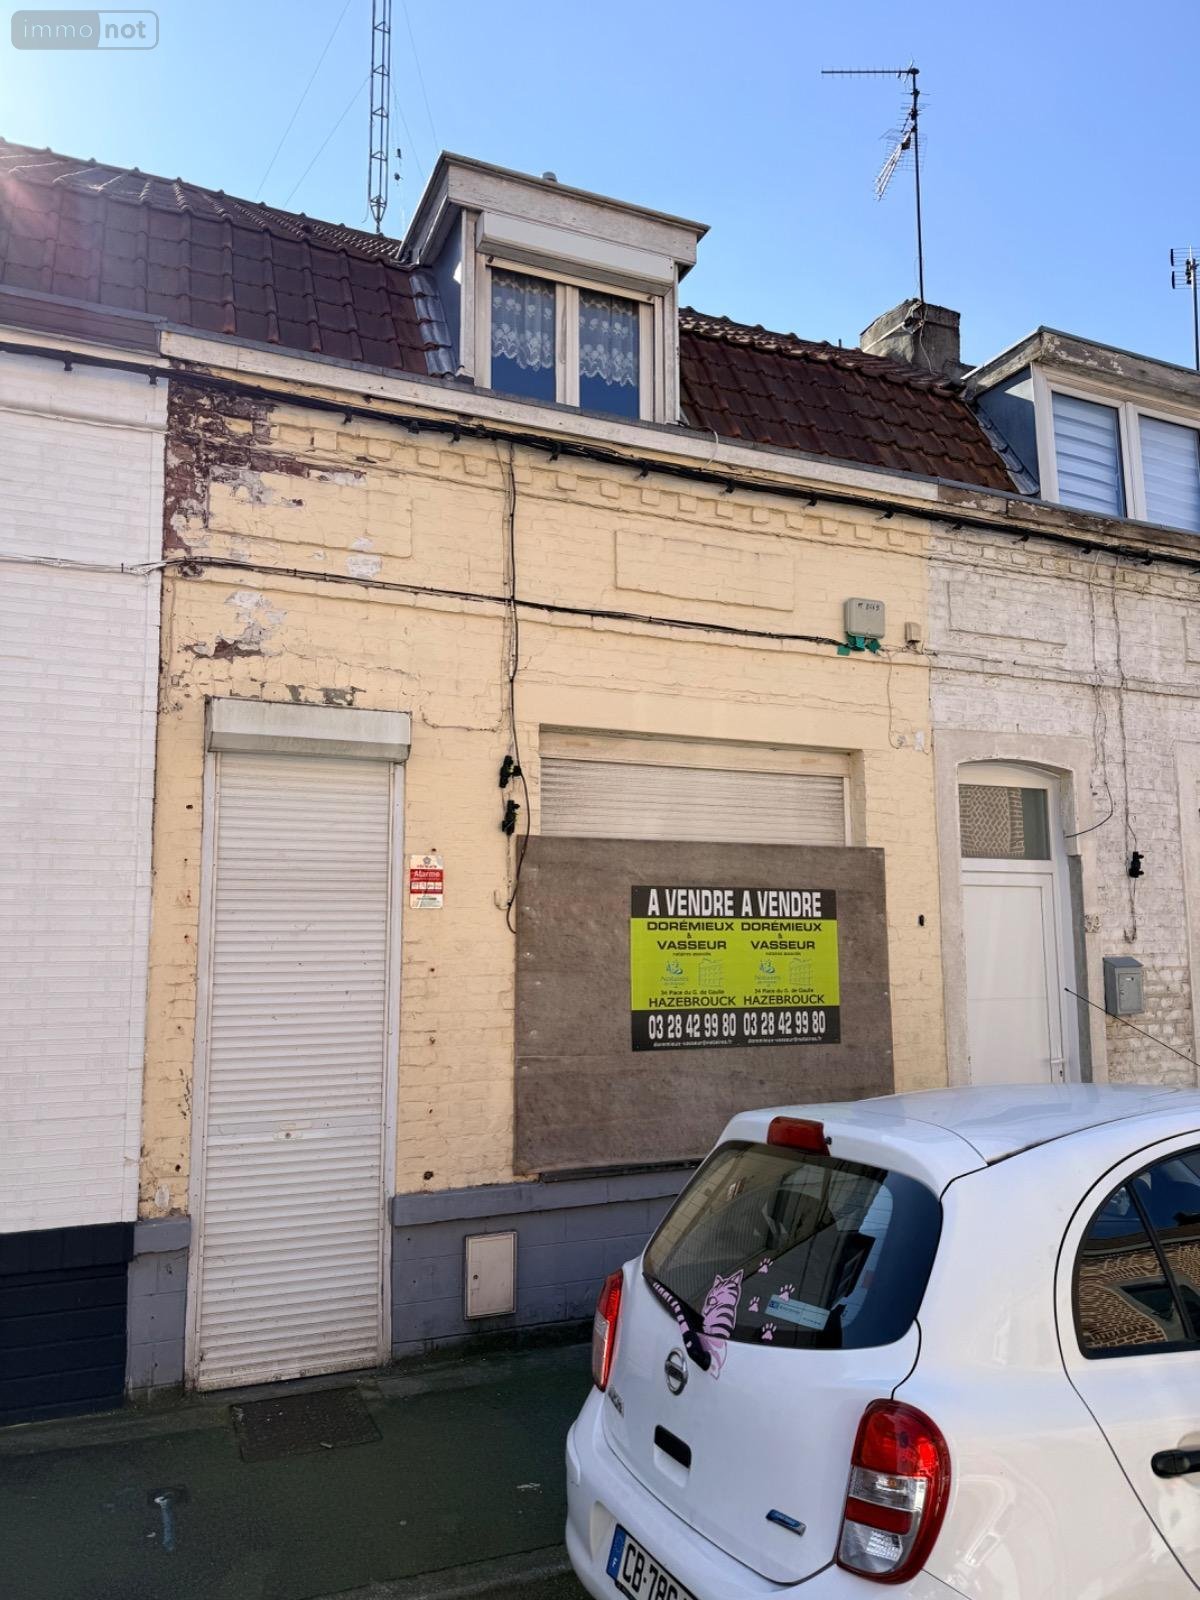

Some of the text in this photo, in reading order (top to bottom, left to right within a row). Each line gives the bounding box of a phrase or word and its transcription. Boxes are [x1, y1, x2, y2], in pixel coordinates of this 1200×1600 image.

[647, 888, 735, 917] A VENDRE
[741, 890, 822, 918] A VENDRE
[647, 919, 735, 931] DORÉMIEUX
[741, 920, 822, 932] DORÉMIEUX
[657, 940, 727, 950] VASSEUR
[750, 940, 816, 950] VASSEUR
[649, 996, 736, 1008] HAZEBROUCK
[743, 994, 825, 1006] HAZEBROUCK
[648, 1012, 737, 1039] 03 28 42 99 80
[743, 1010, 826, 1036] 03 28 42 99 80
